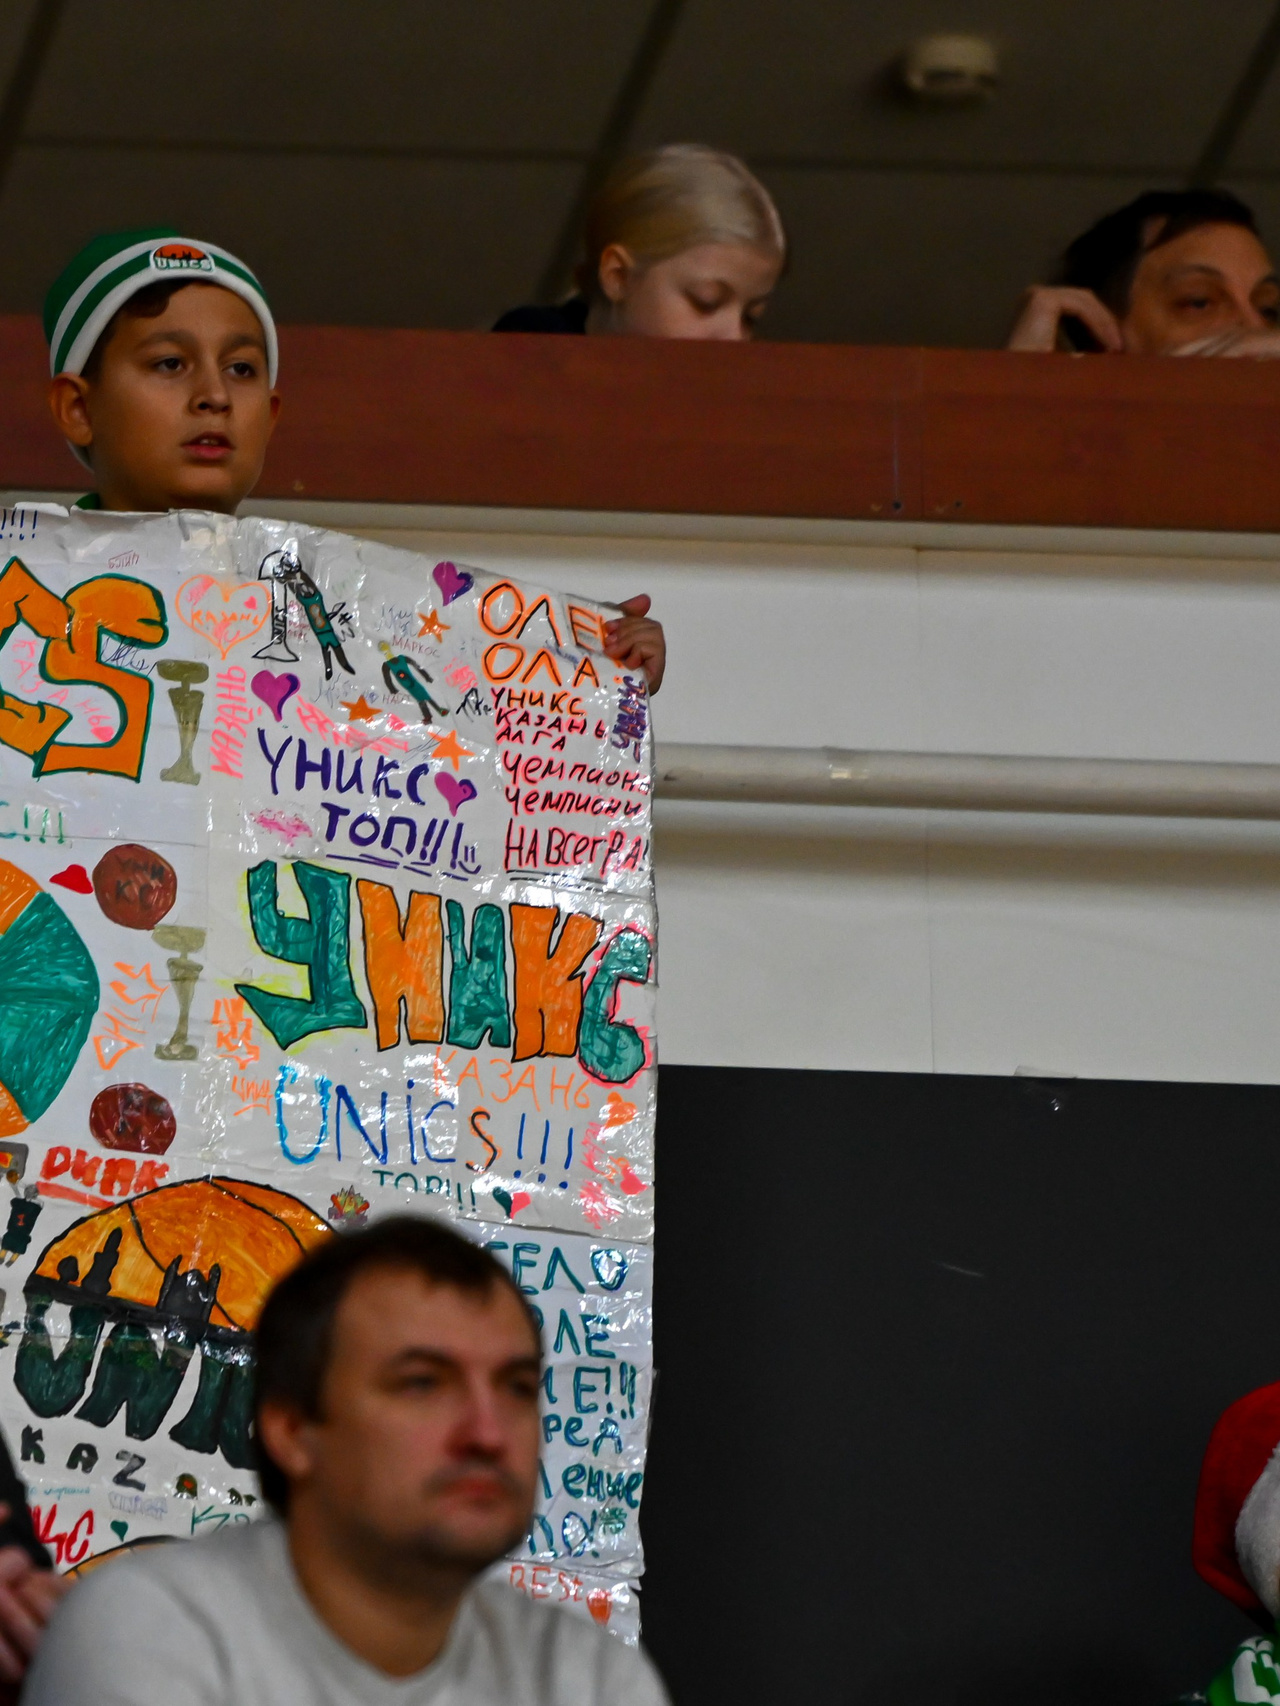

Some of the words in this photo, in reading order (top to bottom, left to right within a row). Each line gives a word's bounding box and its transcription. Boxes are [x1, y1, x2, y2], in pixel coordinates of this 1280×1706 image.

[491, 686, 588, 717] УНИКС
[494, 707, 609, 740] КАЗАНЬ
[496, 726, 567, 751] АЛГА
[257, 727, 431, 806] УНИКС
[233, 859, 654, 1086] УНИКС
[432, 1046, 592, 1112] КАЗАНЬ
